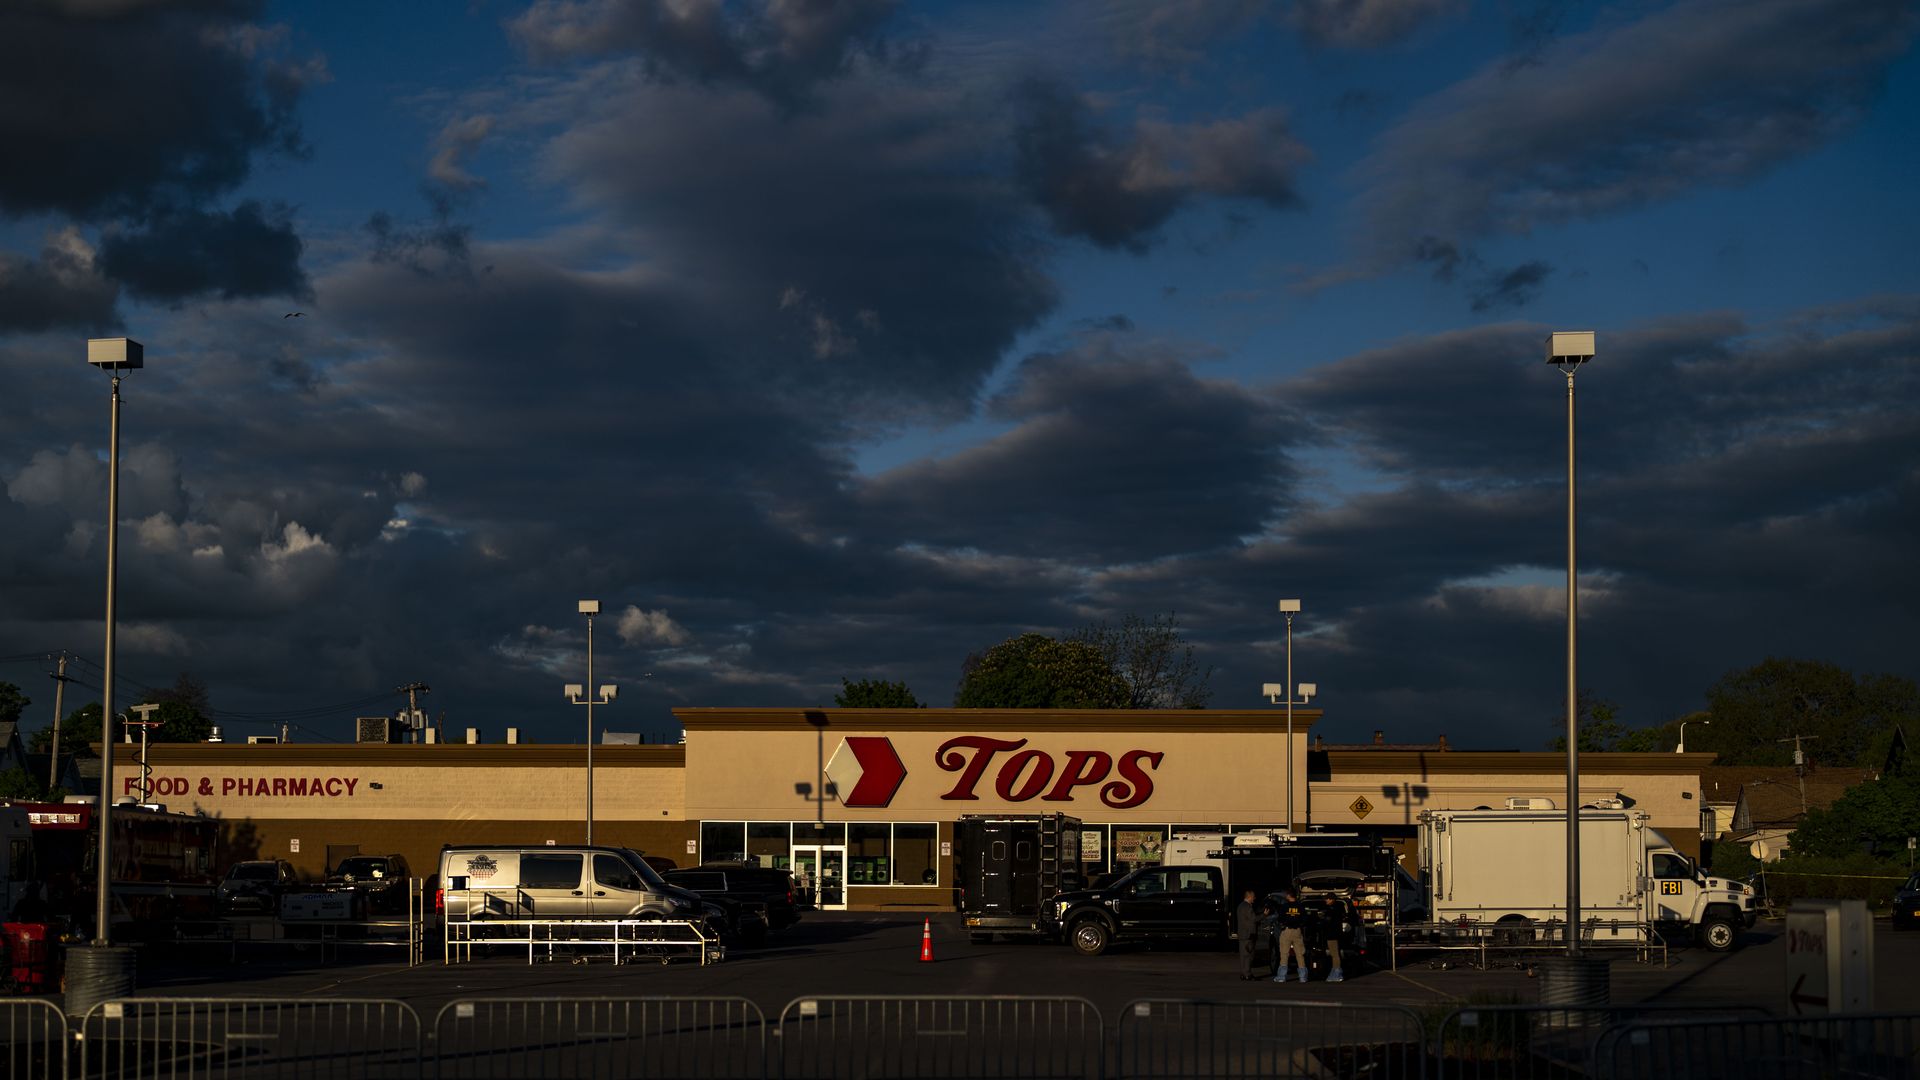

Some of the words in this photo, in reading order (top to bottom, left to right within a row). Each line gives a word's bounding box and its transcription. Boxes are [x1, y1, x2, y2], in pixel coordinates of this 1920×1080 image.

[935, 735, 1165, 809] TOPS
[124, 777, 189, 795] FOOD
[198, 777, 214, 796] &
[222, 777, 359, 796] PHARMACY
[1662, 881, 1682, 895] FBI
